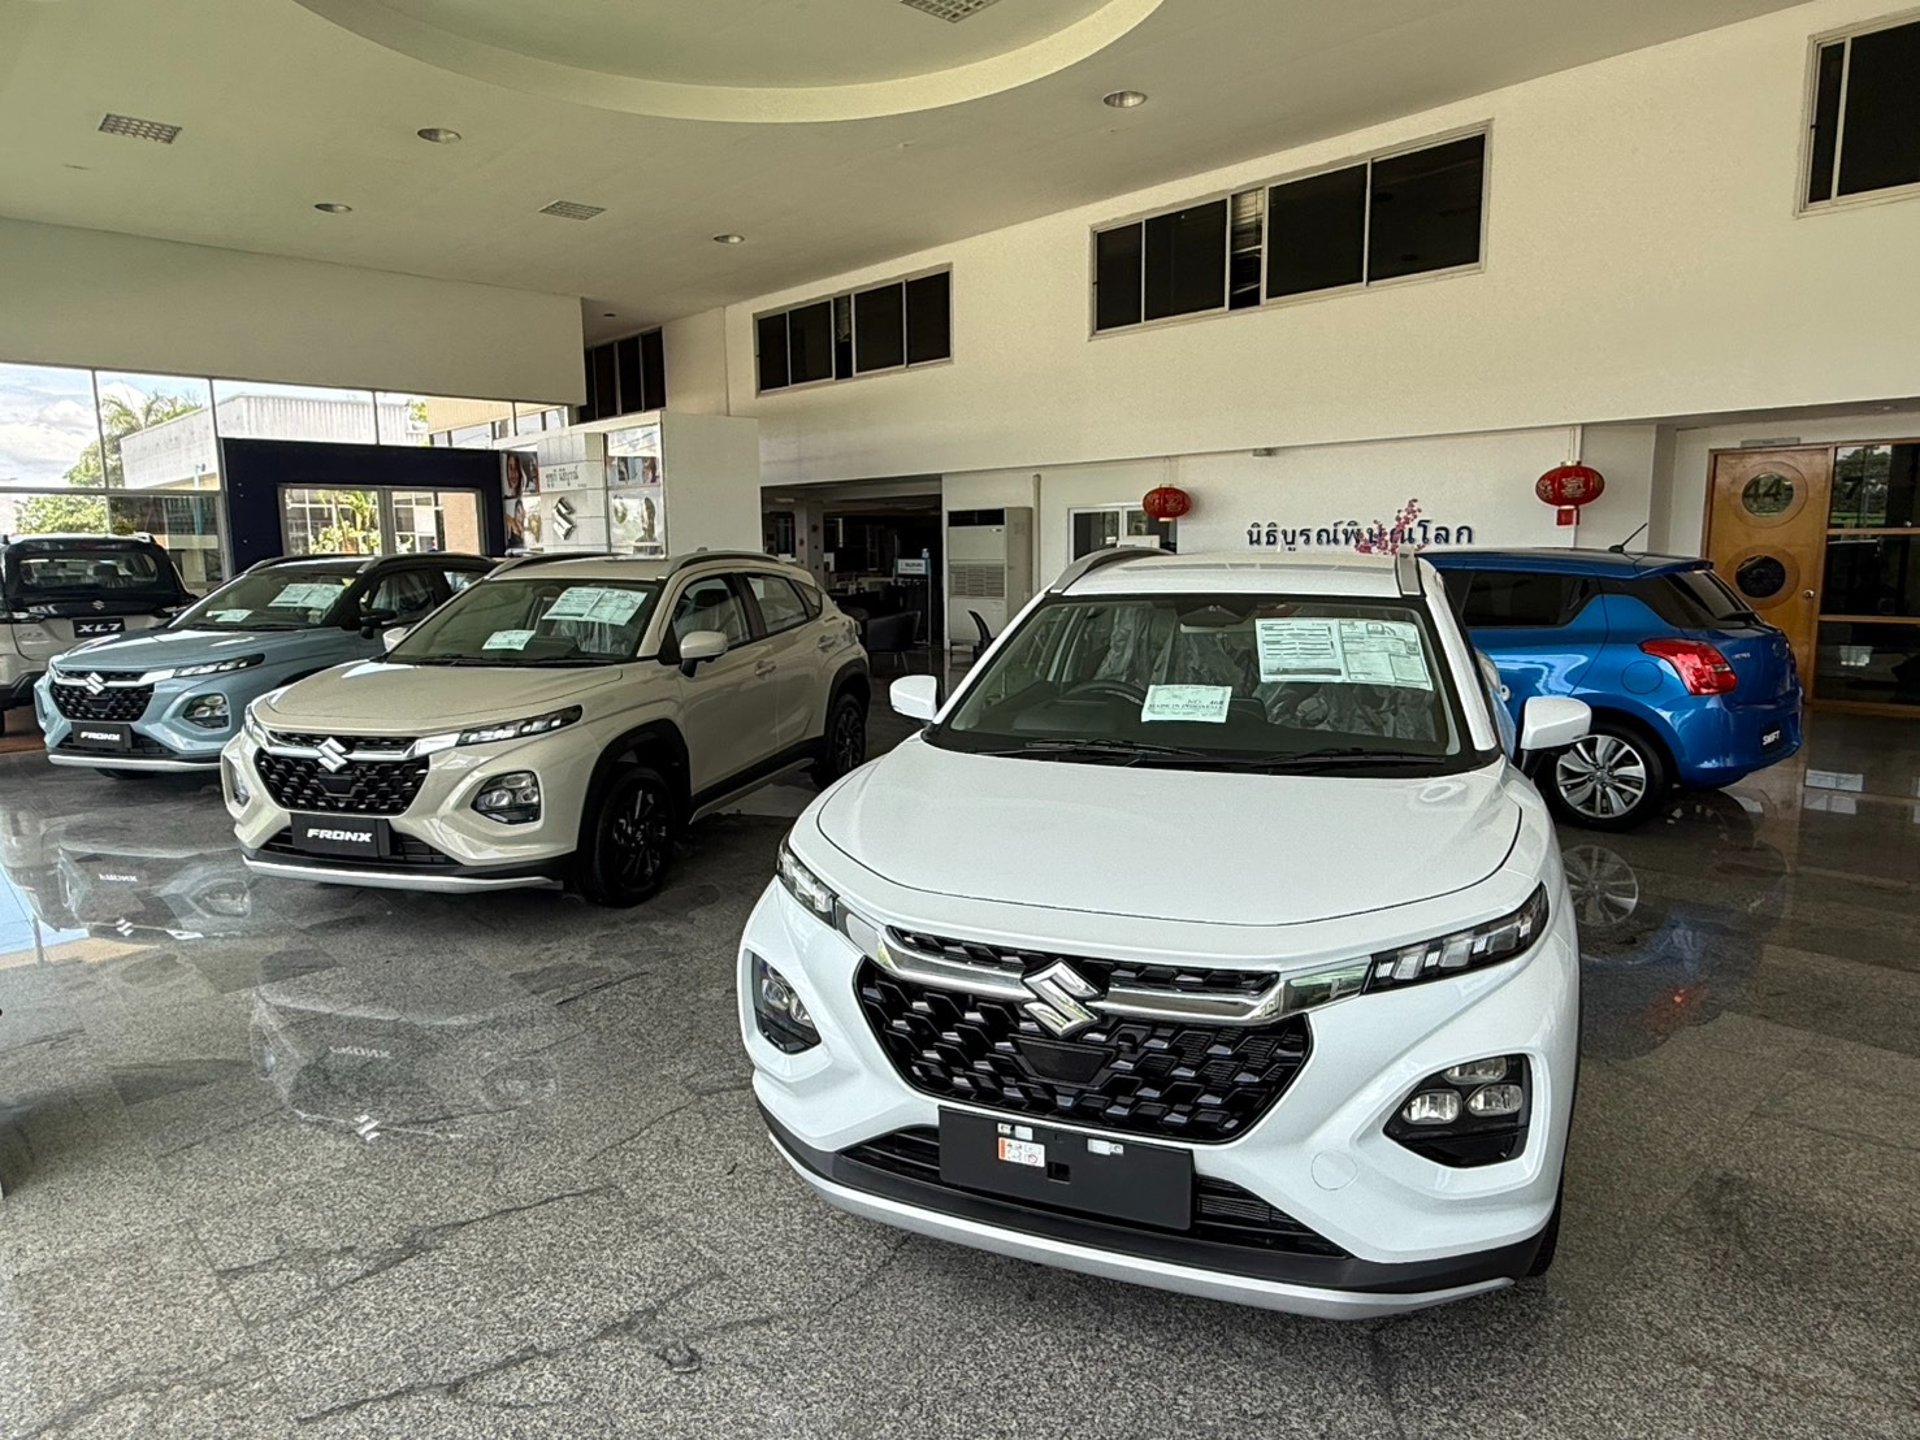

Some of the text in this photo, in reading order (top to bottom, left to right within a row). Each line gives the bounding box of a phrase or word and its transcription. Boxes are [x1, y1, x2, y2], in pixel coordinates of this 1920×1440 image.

[1246, 519, 1474, 551] นิธิบูรณ์พิษณโลก
[77, 623, 122, 633] XL7
[80, 731, 121, 741] FRONX
[306, 828, 373, 843] FRONX
